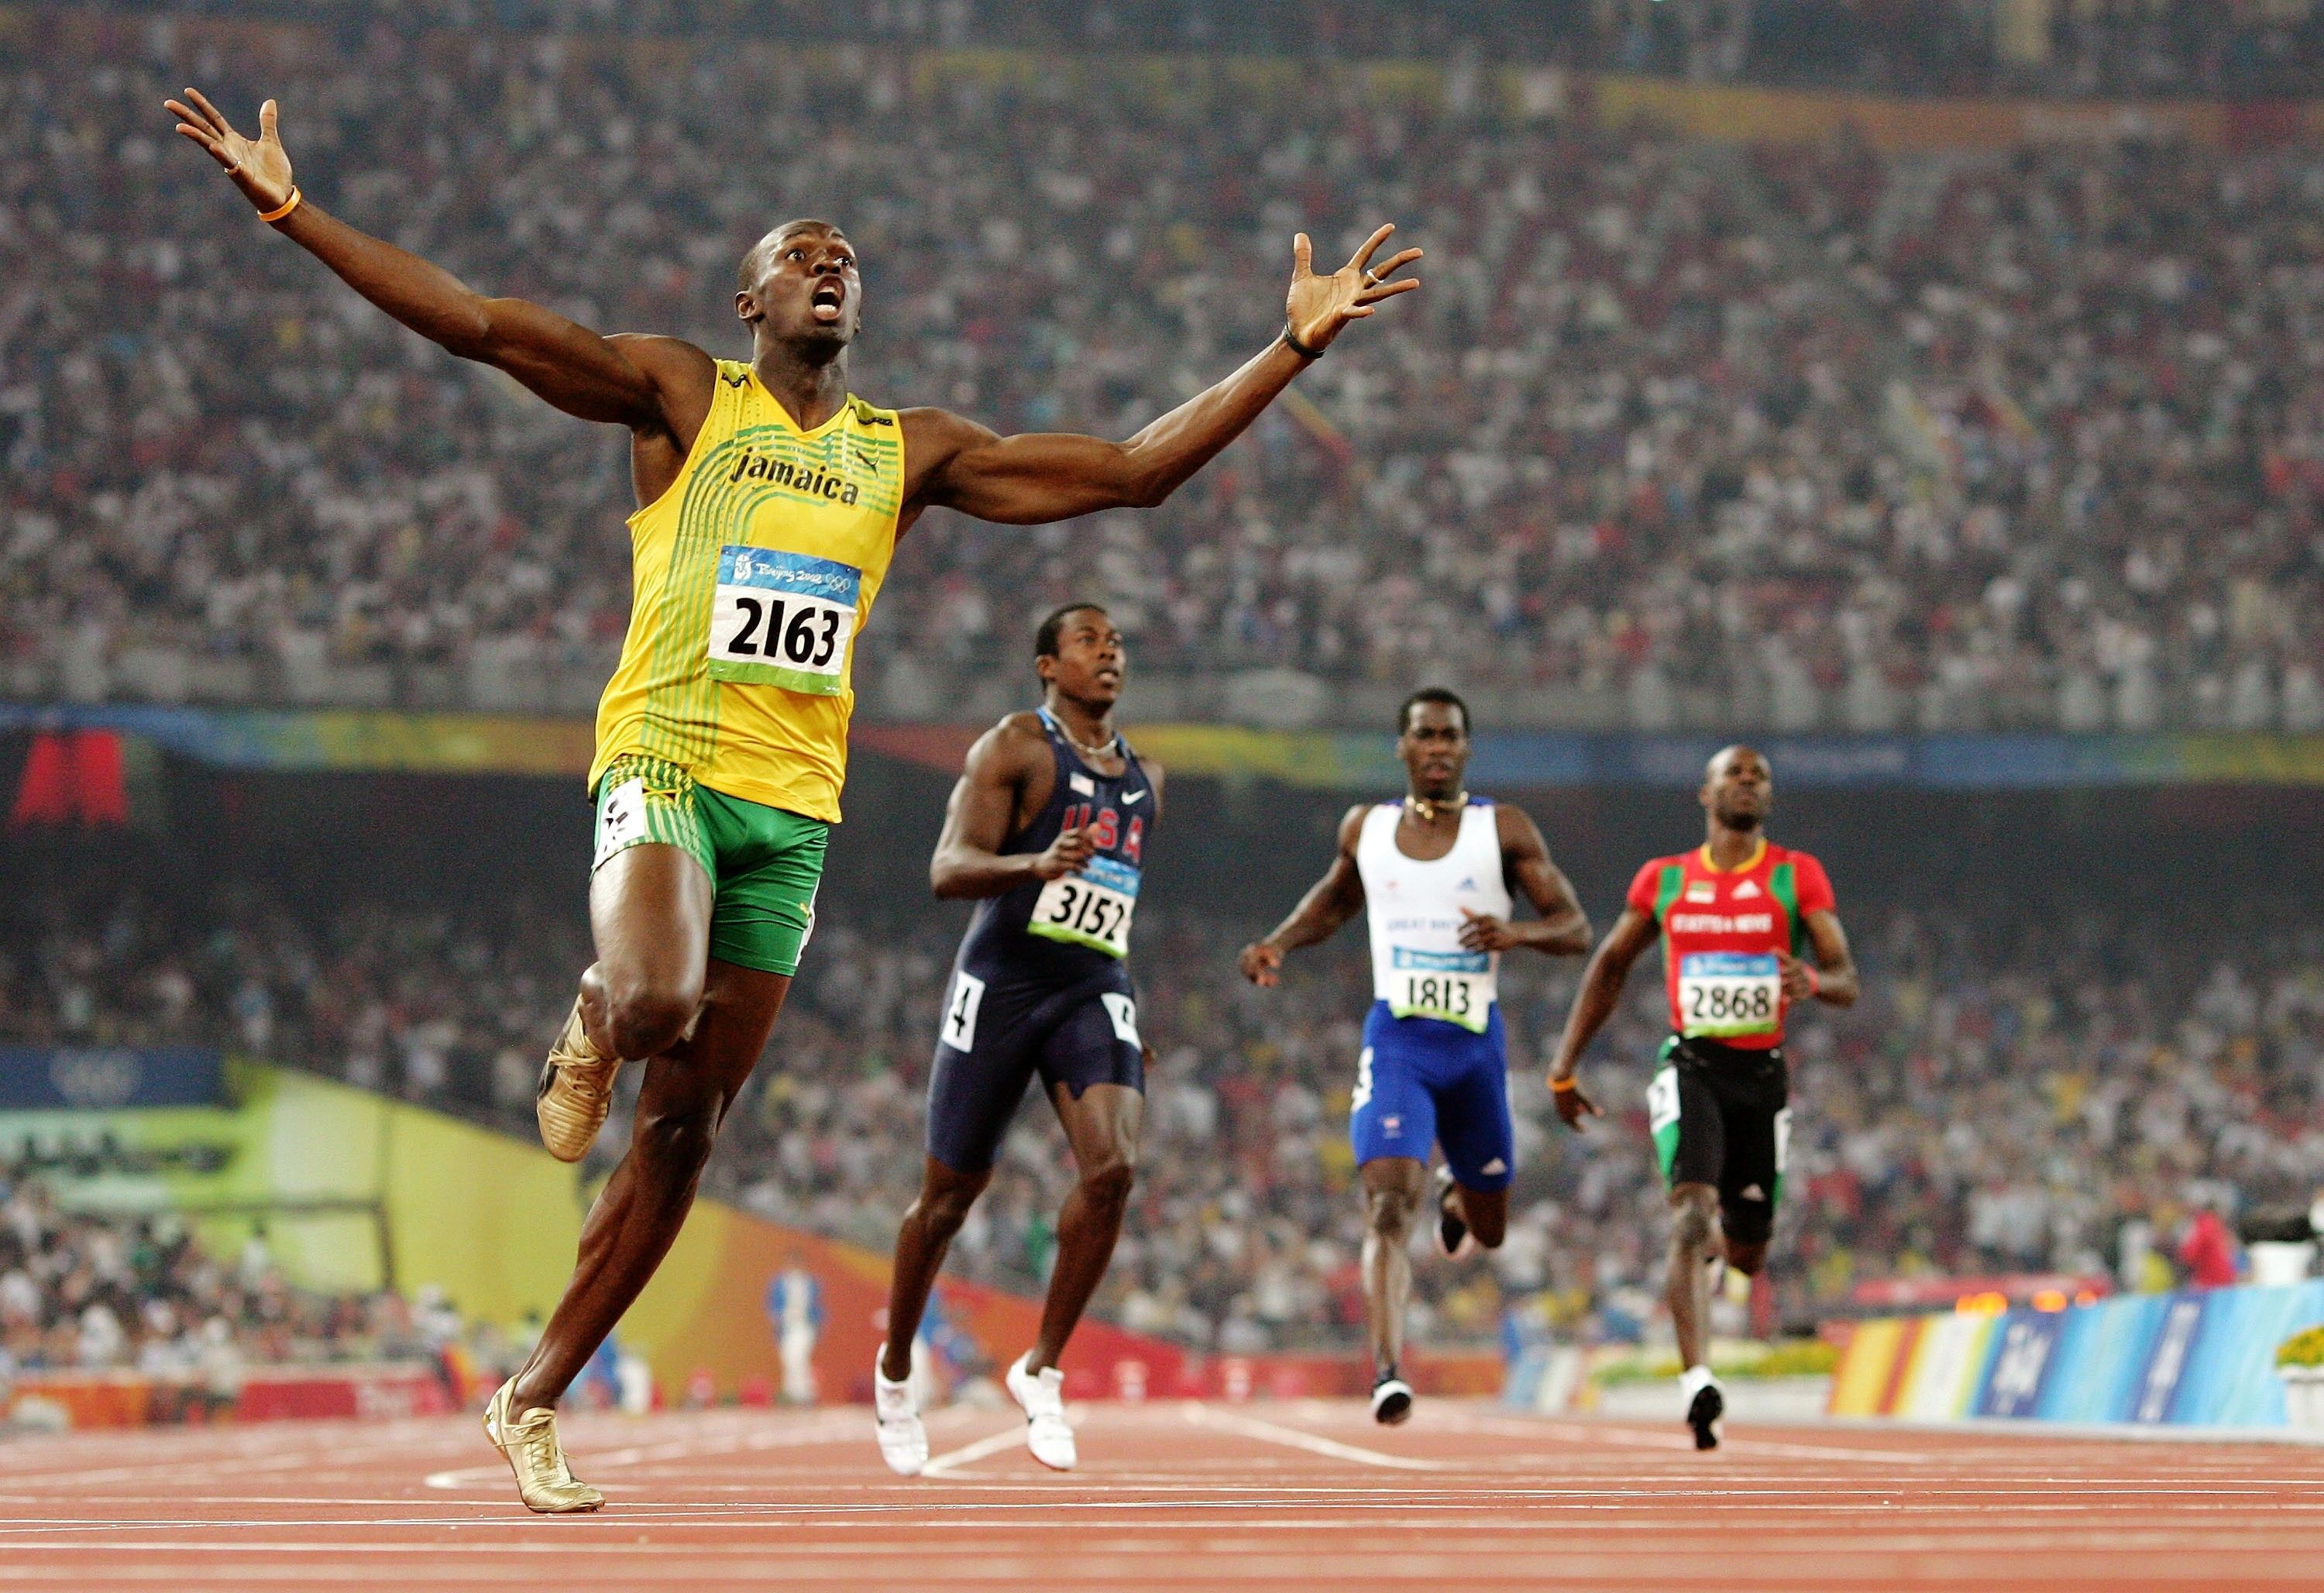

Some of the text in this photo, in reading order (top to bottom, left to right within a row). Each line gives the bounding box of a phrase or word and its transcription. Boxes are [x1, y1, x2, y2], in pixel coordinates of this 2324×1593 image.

[755, 563, 794, 583] Beijing
[728, 597, 839, 666] 2163
[1062, 803, 1143, 864] USA
[1050, 886, 1124, 941] 3152
[1409, 978, 1469, 1015] 1813
[1691, 986, 1769, 1018] 2868
